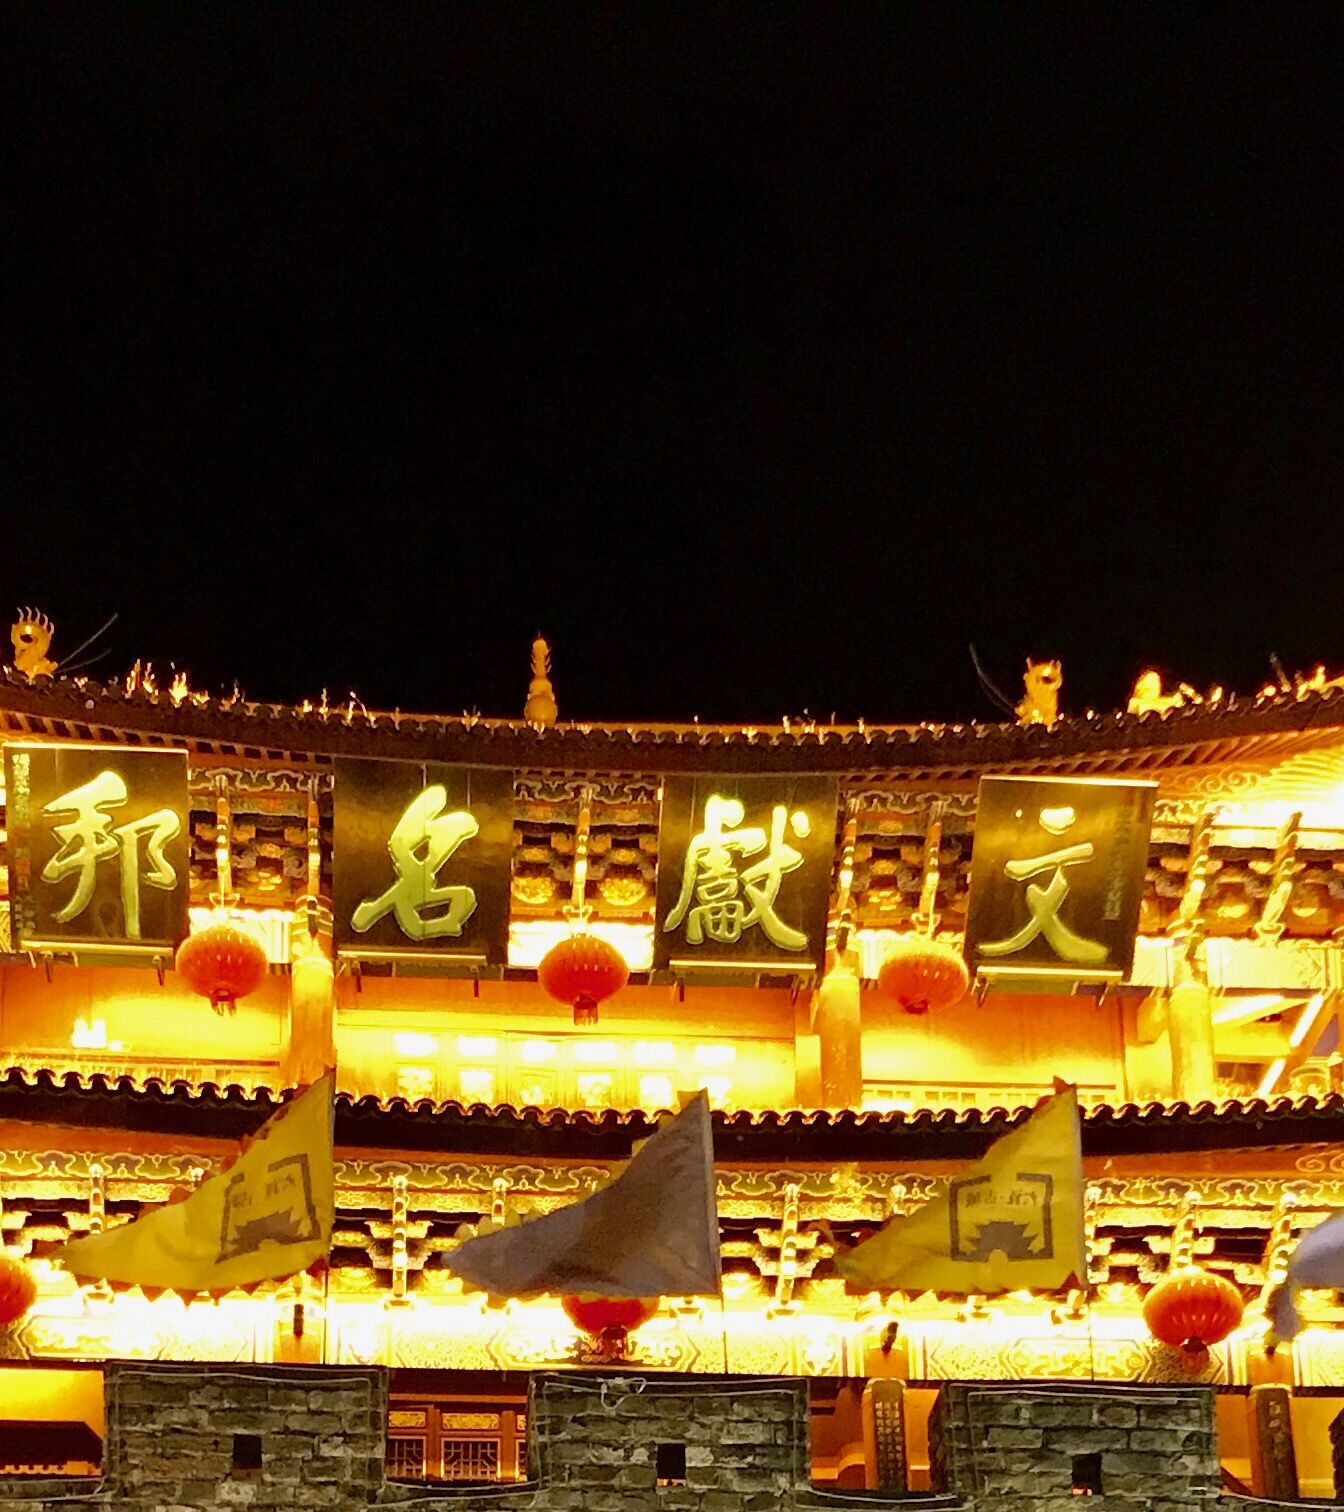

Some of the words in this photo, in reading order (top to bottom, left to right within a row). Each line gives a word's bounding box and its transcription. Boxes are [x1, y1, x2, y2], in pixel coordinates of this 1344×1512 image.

[40, 770, 181, 940] 邦
[350, 783, 479, 941] 名
[976, 806, 1111, 961] 文
